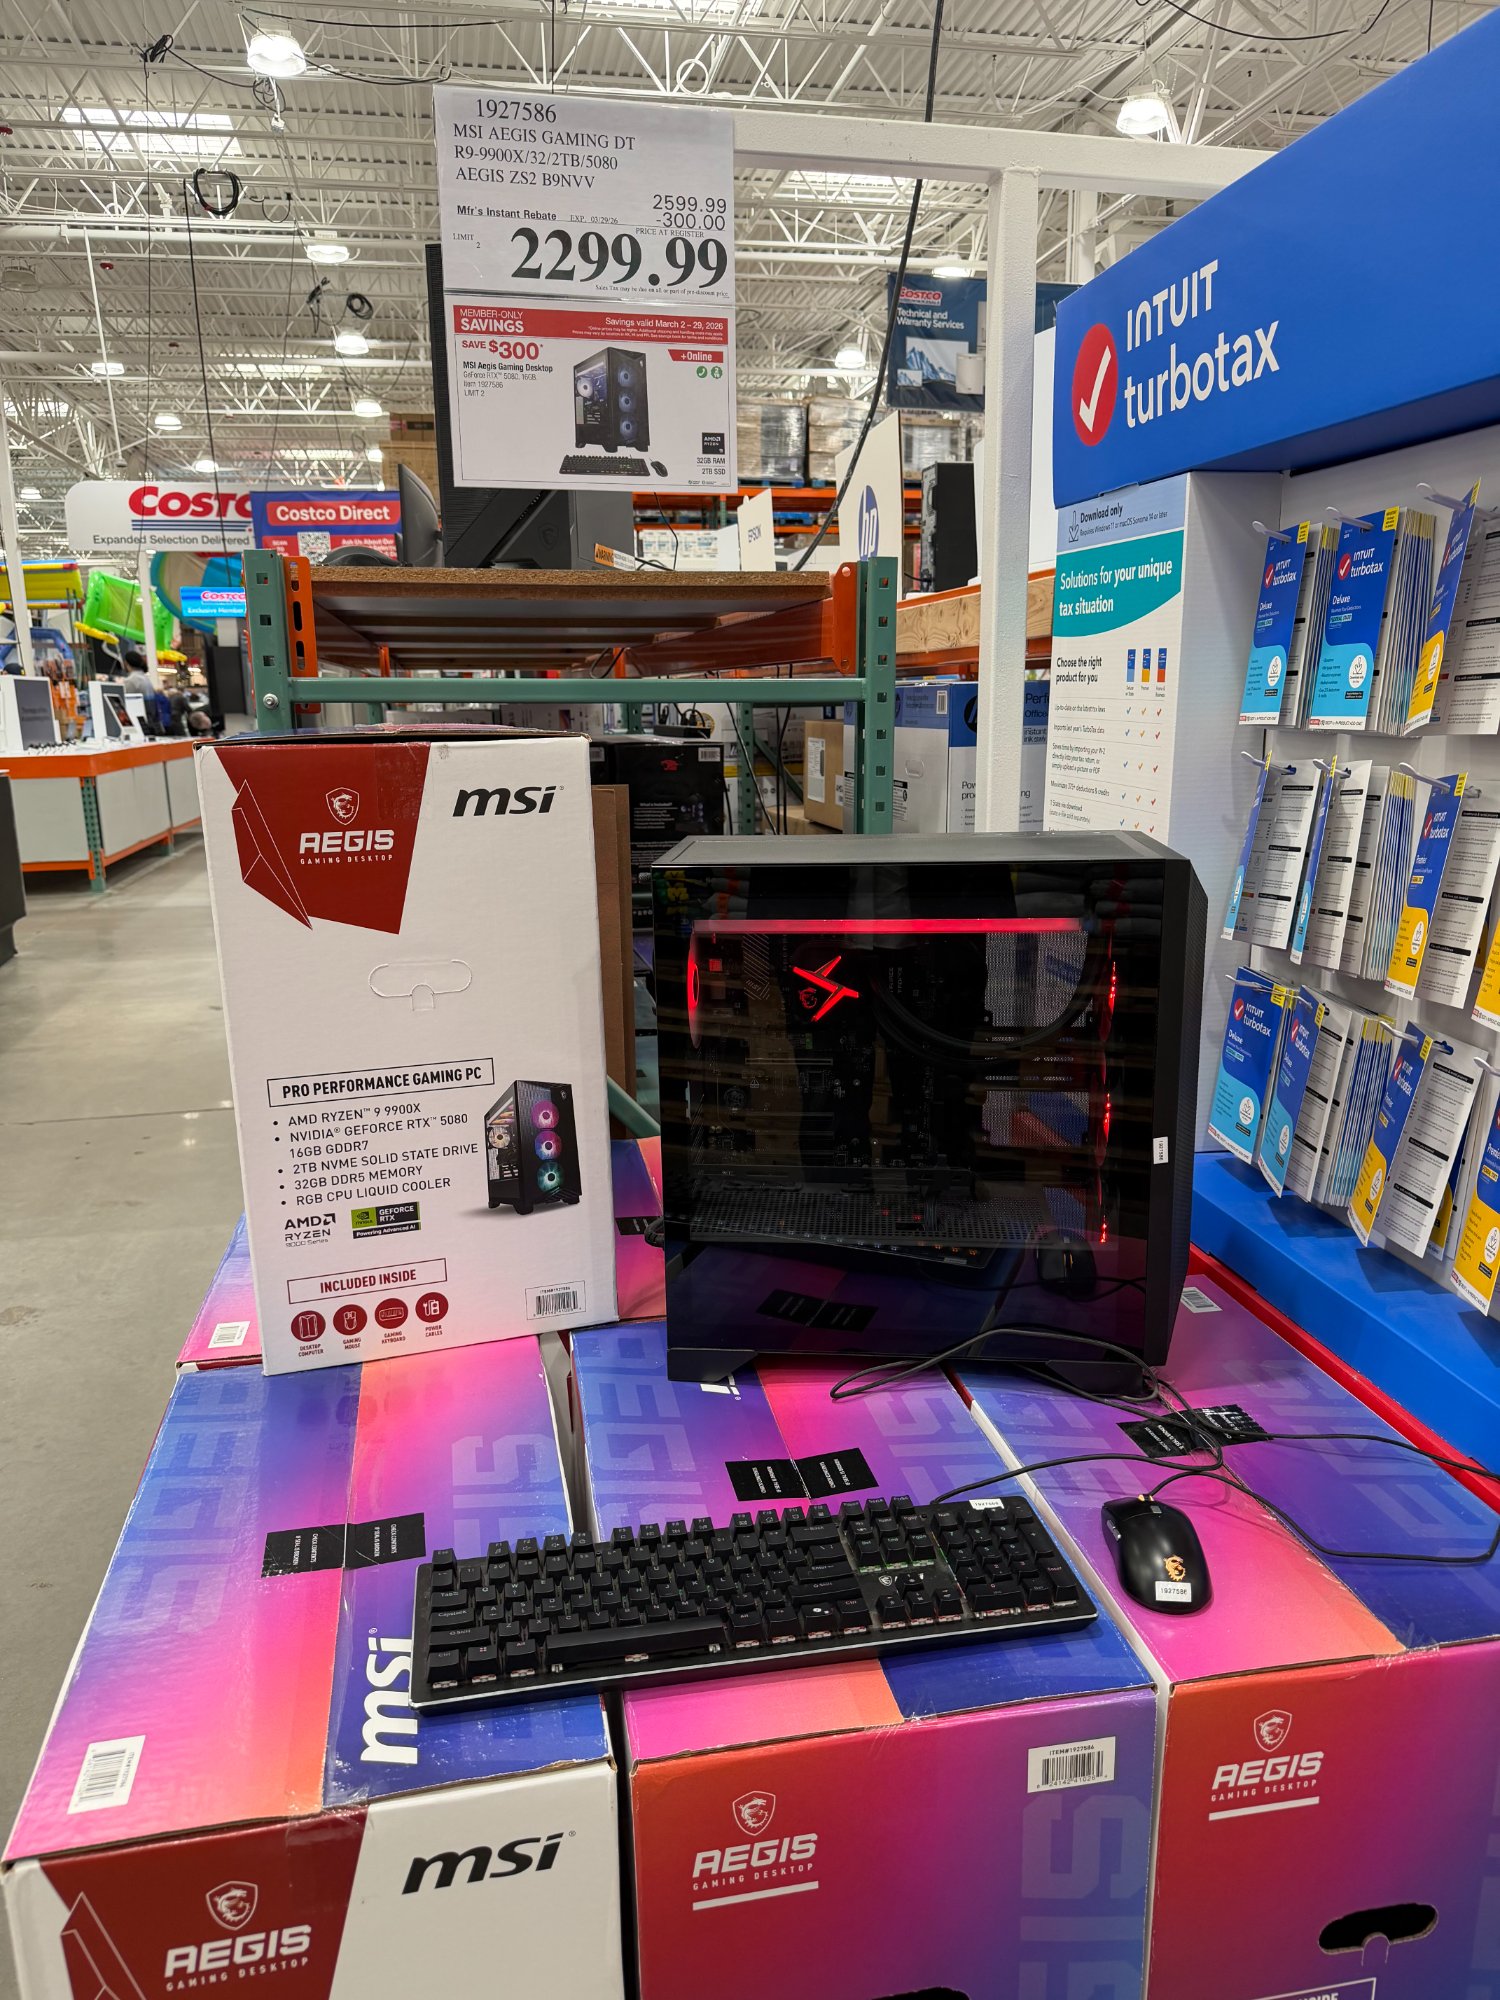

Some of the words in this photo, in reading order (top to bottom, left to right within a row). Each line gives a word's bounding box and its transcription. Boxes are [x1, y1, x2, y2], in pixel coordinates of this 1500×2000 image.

[476, 98, 556, 124] 1927586
[454, 123, 483, 139] MSI
[488, 127, 537, 143] AEGIS
[542, 131, 609, 148] GAMING
[614, 136, 636, 150] DT
[454, 145, 618, 170] R9-9900X/32/2TB/5080
[456, 167, 504, 183] AEGIS
[509, 170, 537, 185] ZS2
[542, 172, 595, 188] B9NVV
[653, 194, 727, 213] 2599.99
[457, 205, 483, 216] Mfr's
[486, 207, 520, 219] Instant
[523, 209, 557, 221] Rebate
[570, 215, 587, 223] EXP.
[656, 212, 726, 231] -300.00
[453, 233, 474, 241] LIMIT
[635, 228, 657, 236] PRICE
[670, 229, 705, 239] REGISTER
[510, 227, 728, 289] 2299.99
[460, 308, 523, 319] MEMBER-ONLY
[897, 307, 932, 319] Technical
[932, 311, 948, 319] and
[1127, 258, 1219, 353] INTUIT
[461, 318, 524, 333] SAVINGS
[605, 317, 635, 327] Savings
[636, 318, 654, 327] valid
[655, 320, 679, 328] March
[681, 321, 686, 329] 2
[693, 321, 704, 331] 29,
[706, 322, 723, 330] 2026
[896, 316, 932, 329] Warranty
[932, 320, 965, 330] Services
[462, 340, 486, 349] SAVE
[681, 351, 713, 361] +Online
[463, 361, 476, 369] MSI
[478, 362, 497, 371] Aegis
[498, 363, 524, 372] Gaming
[525, 364, 553, 373] Desktop
[463, 371, 486, 379] GeForce
[1124, 320, 1280, 429] turbotax
[464, 389, 479, 397] LIMIT
[128, 486, 253, 519] COSTC
[276, 505, 336, 521] Costco
[338, 505, 391, 520] Direct
[1080, 505, 1109, 523] Download
[1110, 502, 1124, 518] only
[93, 535, 147, 546] Expanded
[150, 535, 199, 545] Selection
[201, 535, 250, 545] Delivered
[747, 524, 762, 543] EPSON
[1353, 547, 1375, 561] INTUIT
[1060, 570, 1098, 590] Solutions
[1100, 565, 1113, 584] for
[1114, 566, 1136, 588] your
[1138, 557, 1173, 582] unique
[1350, 561, 1384, 578] turbotax
[1272, 571, 1297, 586] turbotax
[201, 591, 245, 600] COSTCO
[1332, 595, 1351, 605] Deluxe
[1059, 600, 1073, 617] tax
[1075, 594, 1114, 616] situation
[1056, 656, 1077, 668] Choose
[1078, 657, 1087, 667] the
[1088, 656, 1102, 670] right
[1056, 673, 1079, 685] product
[1079, 671, 1087, 682] for
[1087, 674, 1098, 685] you
[299, 828, 395, 854] AEGIS
[300, 856, 341, 865] GAMING
[347, 854, 394, 863] DESKTOP
[1246, 1003, 1265, 1020] INTUIT
[1243, 1013, 1271, 1037] turbotax
[1229, 1029, 1244, 1044] Deluxe
[282, 1082, 310, 1099] PRO
[312, 1073, 411, 1096] PERFORMANCE
[413, 1068, 463, 1086] GAMING
[465, 1066, 482, 1080] PC
[288, 1113, 318, 1127] AMD
[374, 1106, 381, 1117] 9
[384, 1102, 421, 1116] 9900X
[344, 1120, 404, 1137] GEFORCE
[440, 1113, 468, 1126] 5080
[290, 1145, 323, 1159] 16GB
[325, 1140, 369, 1156] GDDR7
[292, 1161, 318, 1175] 2TB
[320, 1156, 359, 1172] NVME
[361, 1152, 400, 1167] SOLID
[402, 1147, 440, 1162] STATE
[441, 1142, 479, 1156] DRIVE
[294, 1176, 328, 1191] 32GB
[330, 1171, 366, 1186] DDR5
[368, 1164, 424, 1182] MEMORY
[295, 1192, 324, 1207] RGB
[325, 1188, 354, 1203] CPU
[356, 1182, 400, 1198] LIQUID
[401, 1176, 452, 1193] COOLER
[379, 1205, 415, 1216] GEFORCE
[379, 1214, 396, 1223] RTX
[284, 1215, 322, 1230] AMD
[285, 1228, 331, 1242] RYZEN
[356, 1229, 382, 1238] Powering
[382, 1225, 409, 1234] Advanced
[319, 1273, 377, 1295] INCLUDED
[379, 1268, 417, 1286] INSIDE
[342, 1337, 362, 1345] GAMING
[381, 1336, 406, 1344] KEYBOARD
[298, 1349, 324, 1357] COMPUTER
[1049, 1744, 1095, 1756] ITEM#1927586
[1211, 1751, 1324, 1790] AEGIS
[1211, 1788, 1257, 1802] GAMING
[1265, 1779, 1318, 1793] DESKTOP
[692, 1832, 819, 1878] AEGIS
[693, 1875, 744, 1891] GAMING
[754, 1863, 814, 1881] DESKTOP
[164, 1924, 312, 1978] AEGIS
[166, 1974, 228, 1991] GAMING
[238, 1957, 309, 1982] DESKTOP
